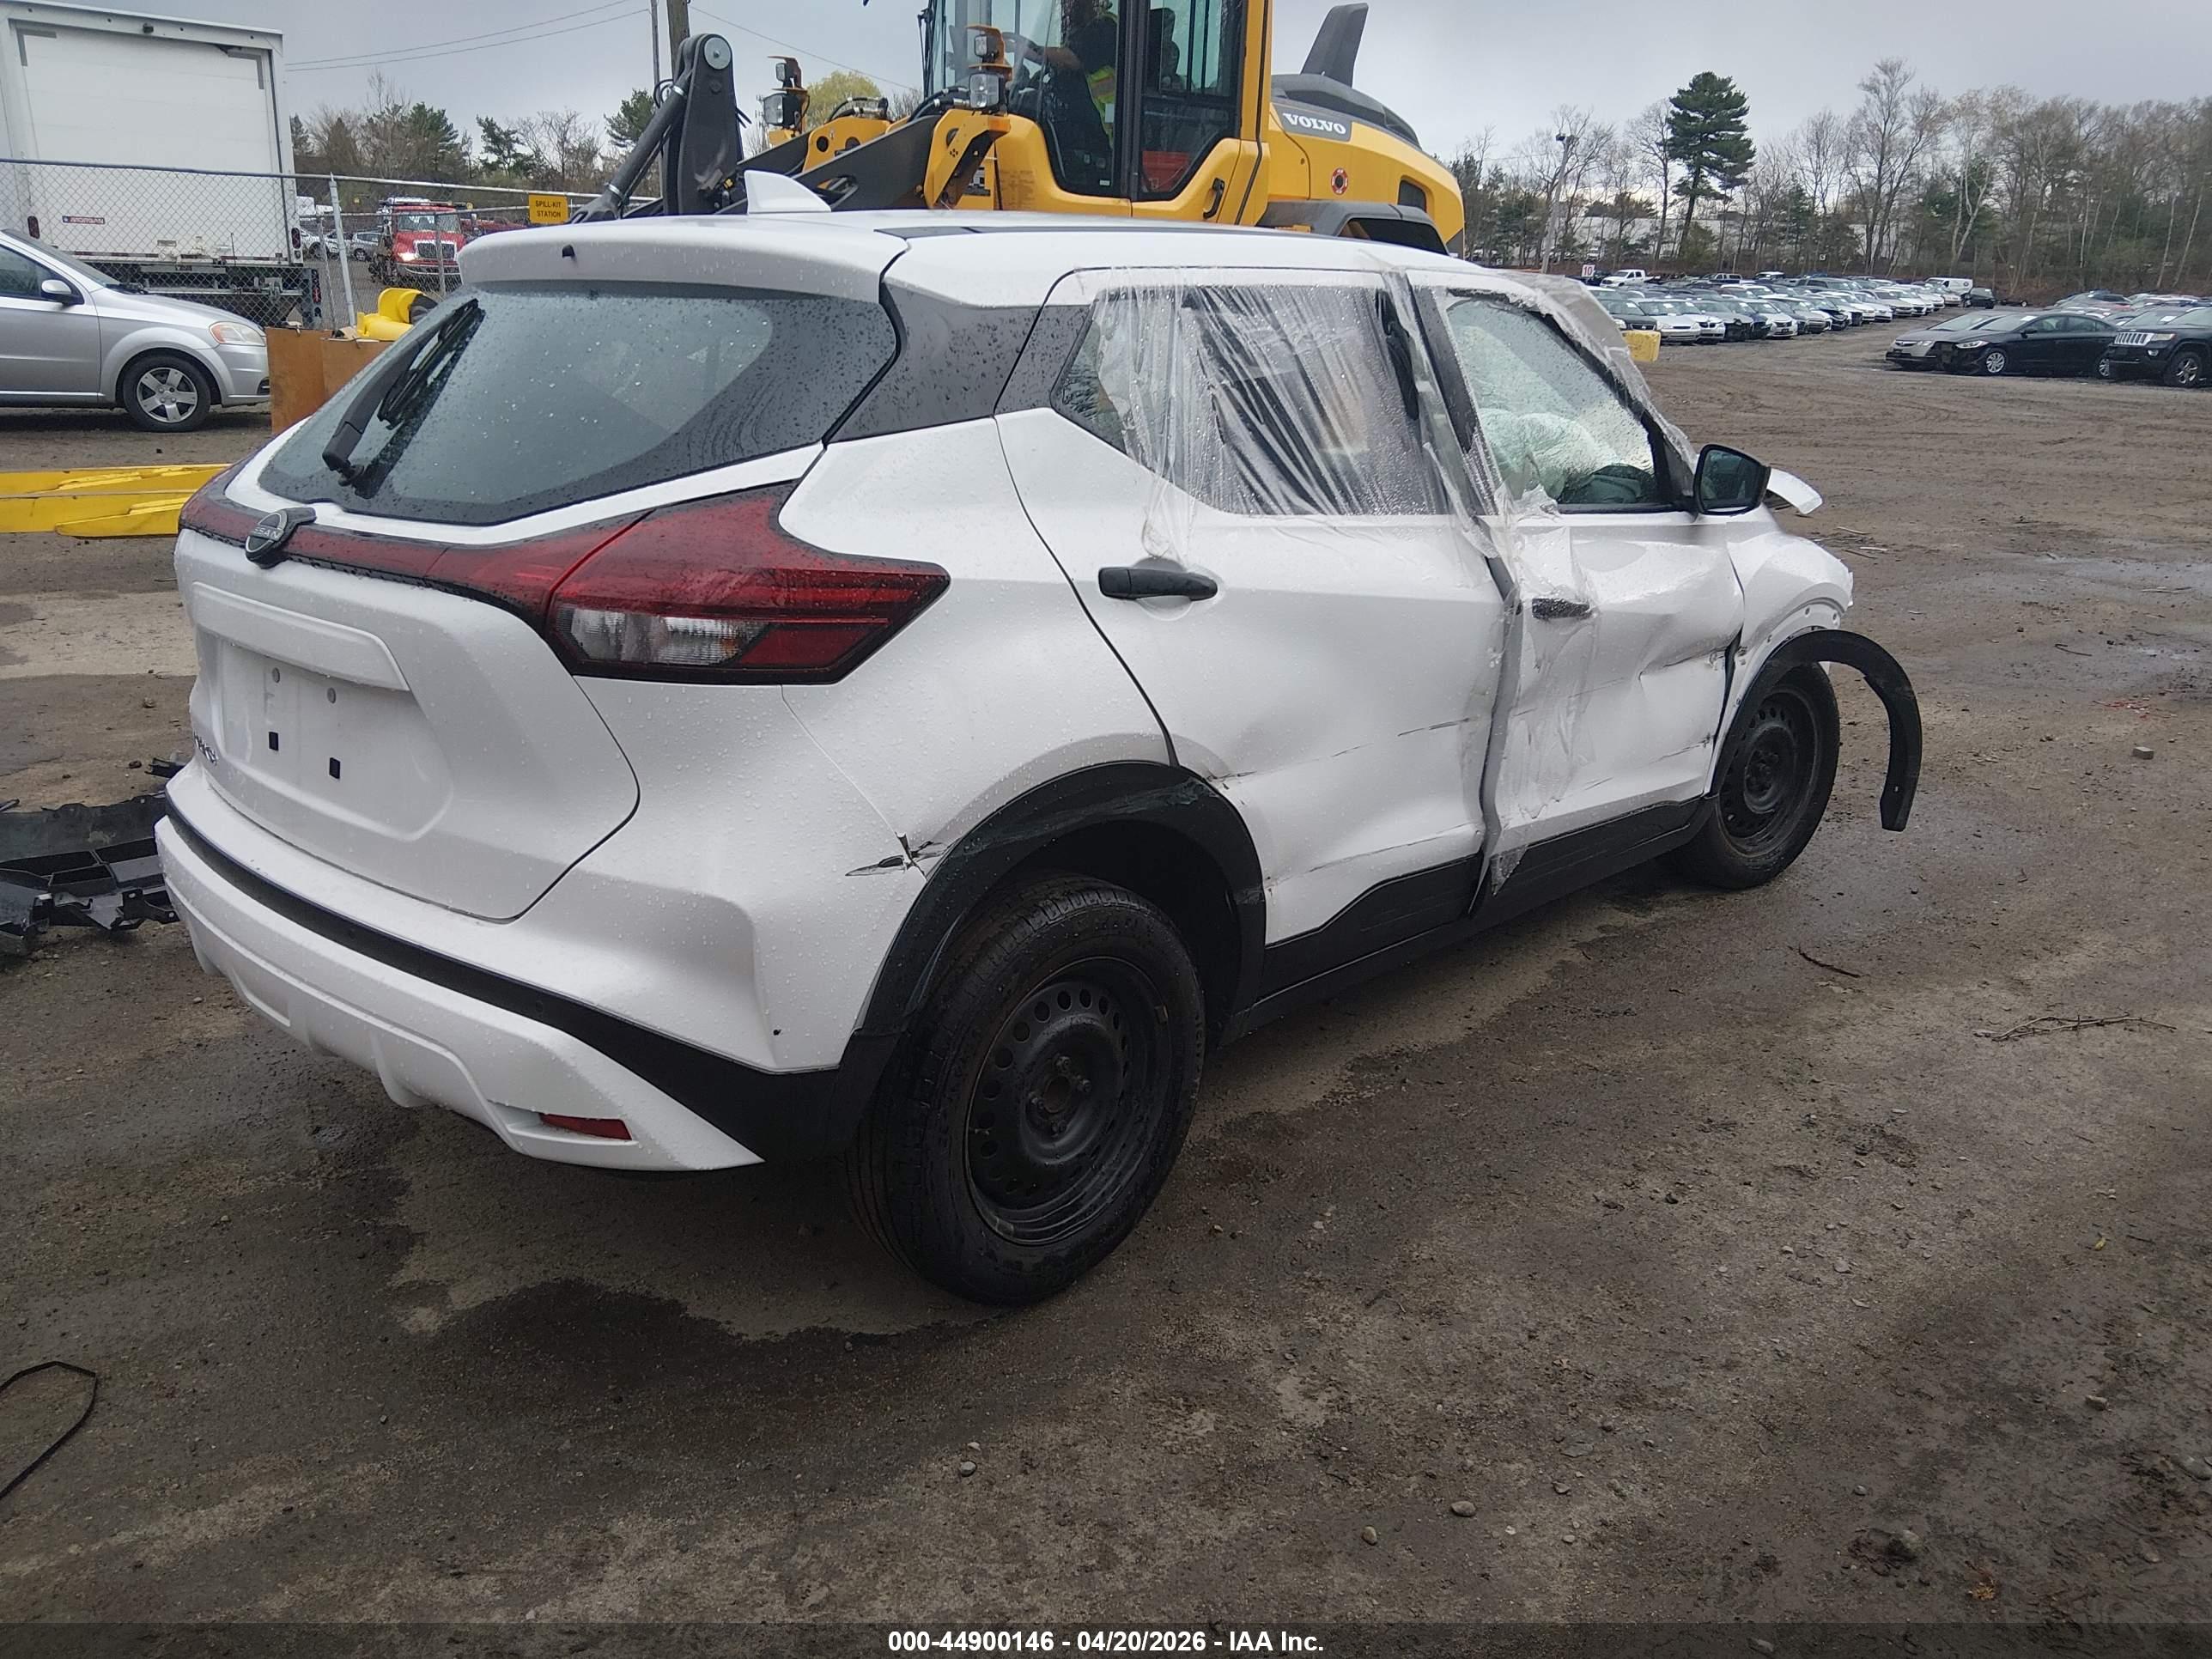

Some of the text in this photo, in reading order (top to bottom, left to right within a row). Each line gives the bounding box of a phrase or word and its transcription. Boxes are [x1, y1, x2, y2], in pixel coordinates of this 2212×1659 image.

[1282, 112, 1346, 135] VOLVO
[536, 210, 562, 218] STATION
[1583, 266, 1593, 276] 10
